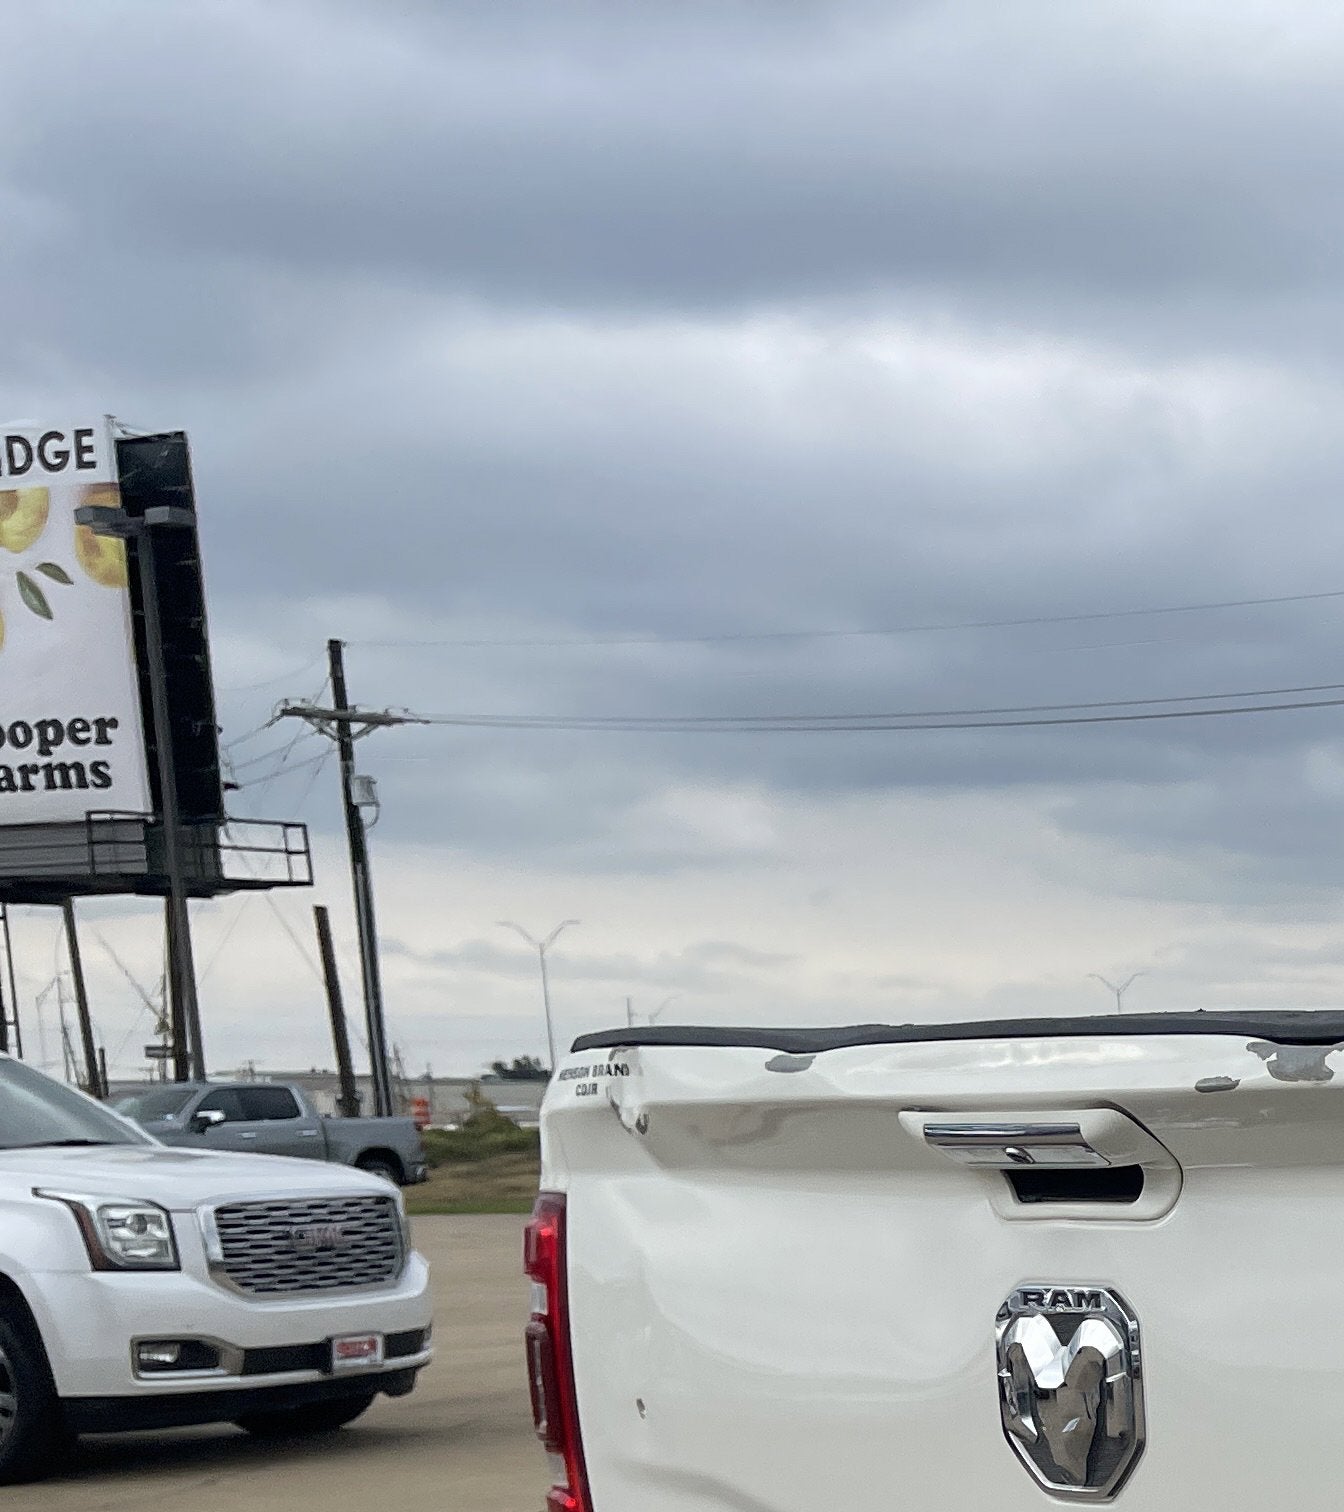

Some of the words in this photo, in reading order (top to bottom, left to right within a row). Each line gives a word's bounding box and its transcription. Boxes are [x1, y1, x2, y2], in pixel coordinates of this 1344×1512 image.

[0, 428, 97, 476] DGE
[0, 717, 119, 757] oper
[1022, 1289, 1103, 1309] RAM
